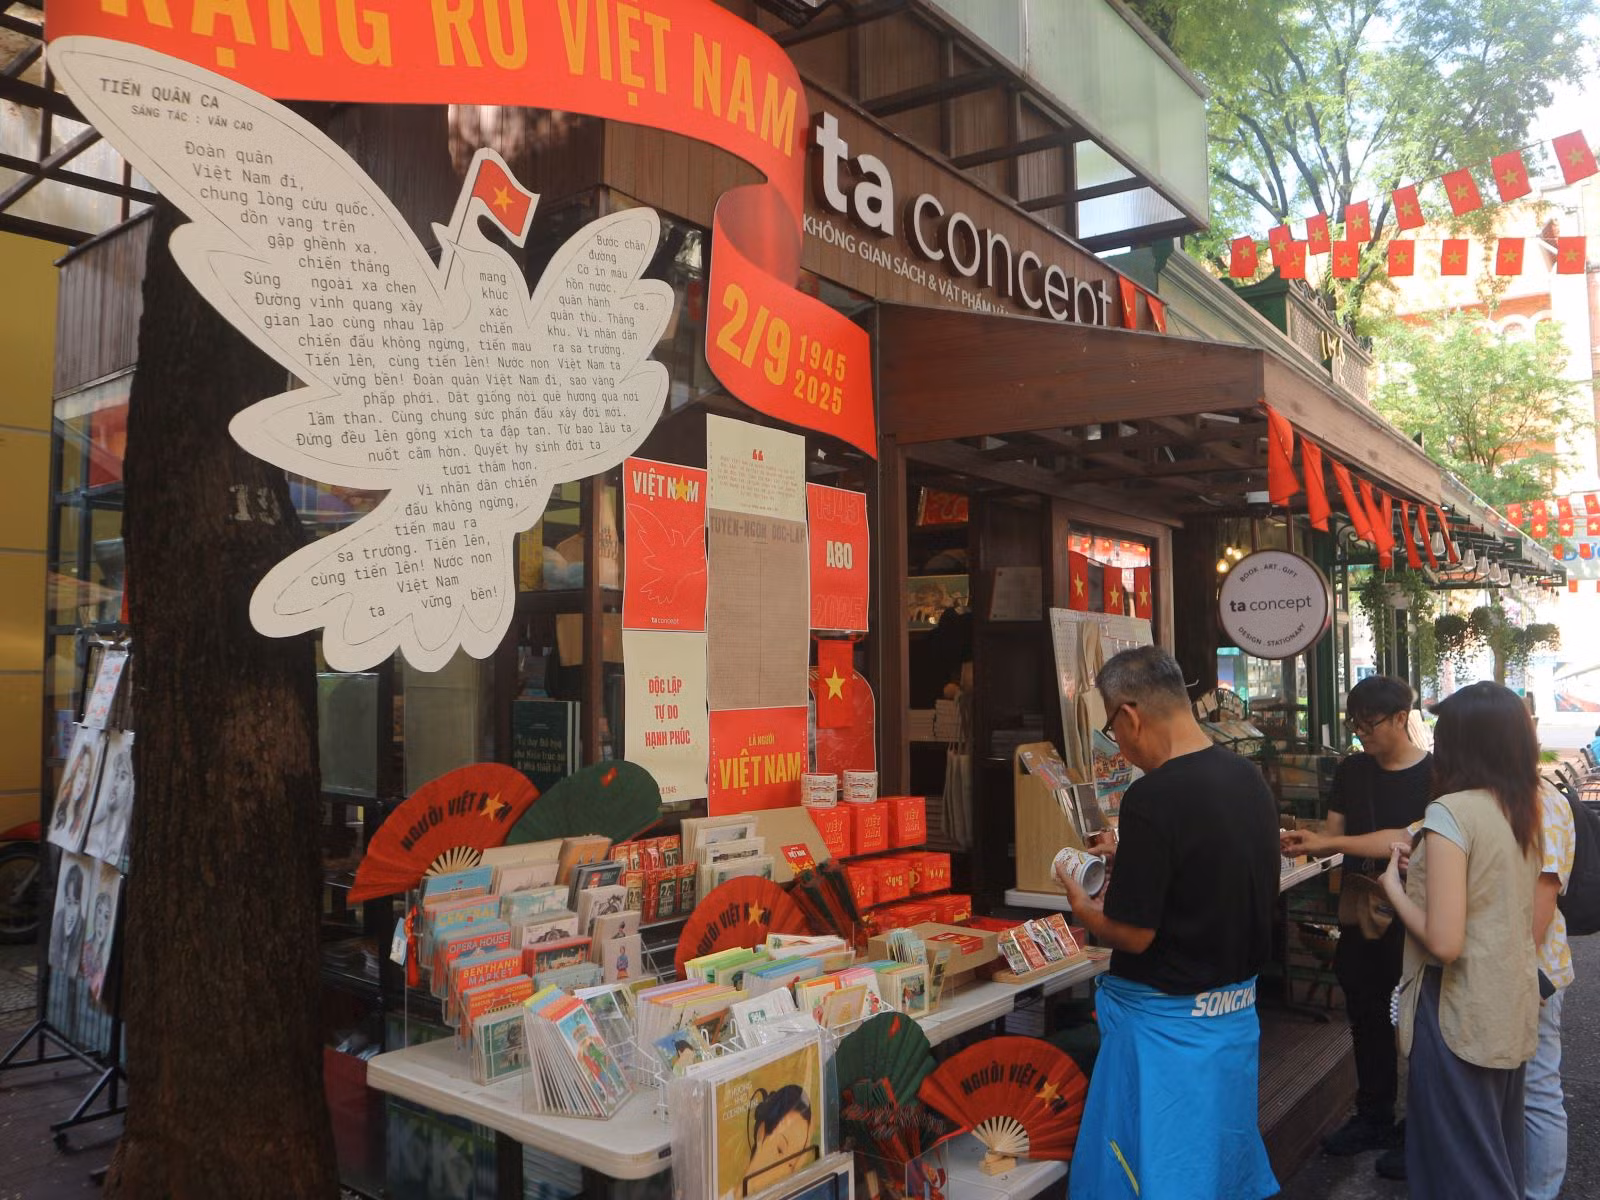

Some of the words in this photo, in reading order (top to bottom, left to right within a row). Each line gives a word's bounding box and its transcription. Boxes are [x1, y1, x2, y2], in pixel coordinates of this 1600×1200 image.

[99, 78, 141, 97] TIẾN
[152, 86, 191, 104] QUÂN
[201, 94, 219, 109] CA
[693, 32, 797, 157] NAM
[131, 103, 160, 118] SÁNG
[234, 121, 253, 131] CAO
[185, 141, 225, 158] Đoàn
[236, 150, 273, 165] quân
[193, 163, 232, 181] Việt
[242, 170, 271, 185] Nam
[280, 174, 303, 191] đi,
[813, 111, 894, 237] ta
[200, 186, 248, 205] chung
[258, 191, 293, 210] lòng
[278, 217, 313, 231] vang
[323, 219, 355, 233] trên
[355, 243, 377, 254] xa.
[803, 213, 856, 253] KHÔNG
[858, 241, 892, 271] GIAN
[893, 257, 926, 286] SÁCH
[928, 274, 937, 291] &
[938, 279, 960, 302] VẬT
[299, 256, 341, 270] chiến
[244, 271, 280, 288] Súng
[362, 280, 378, 291] xa
[386, 281, 416, 294] chen
[479, 272, 507, 285] mang
[312, 296, 344, 308] vinh
[353, 299, 393, 314] quang
[264, 313, 300, 329] gian
[309, 314, 334, 327] lao
[343, 317, 375, 331] cùng
[384, 318, 414, 330] nhau
[479, 322, 513, 334] chiến
[299, 333, 341, 347] chiến
[383, 336, 421, 351] không
[479, 339, 506, 352] tiến
[512, 342, 532, 352] mau
[716, 283, 791, 386] 2/9
[305, 353, 340, 367] Tiến
[428, 354, 456, 368] tiến
[531, 359, 550, 369] non
[587, 360, 605, 370] Nam
[611, 361, 621, 370] ta
[799, 335, 846, 382] 1945
[793, 369, 843, 416] 2025
[441, 481, 469, 493] nhân
[477, 479, 498, 491] dân
[504, 476, 538, 489] chiến
[632, 467, 665, 501] VIỆT
[435, 499, 473, 514] không
[395, 521, 425, 536] tiến
[433, 519, 456, 531] mau
[464, 518, 477, 529] ra
[338, 550, 354, 563] sa
[426, 536, 457, 551] Tiến
[826, 540, 853, 570] A80
[311, 570, 346, 587] cùng
[355, 563, 388, 580] tiến
[396, 558, 424, 575] lên!
[434, 554, 464, 569] Nước
[471, 552, 492, 564] non
[1240, 567, 1258, 582] BOOK
[1263, 563, 1277, 571] ART
[1282, 566, 1298, 578] GIFT
[397, 576, 428, 593] Việt
[436, 574, 459, 587] Nam
[369, 604, 385, 618] ta
[470, 586, 498, 601] bền!
[1229, 600, 1246, 612] ta
[1249, 595, 1312, 613] concept
[1238, 626, 1262, 645] DESIGN
[1266, 623, 1306, 647] STATIONARY
[648, 675, 666, 697] ĐỘC
[667, 675, 682, 696] LẬP
[654, 704, 666, 723] TỰ
[667, 705, 679, 719] DO
[645, 731, 668, 750] HẠNH
[669, 727, 691, 745] PHÚC
[719, 748, 762, 796] VIỆT
[764, 751, 801, 785] NAM
[480, 933, 509, 945] HOUSE
